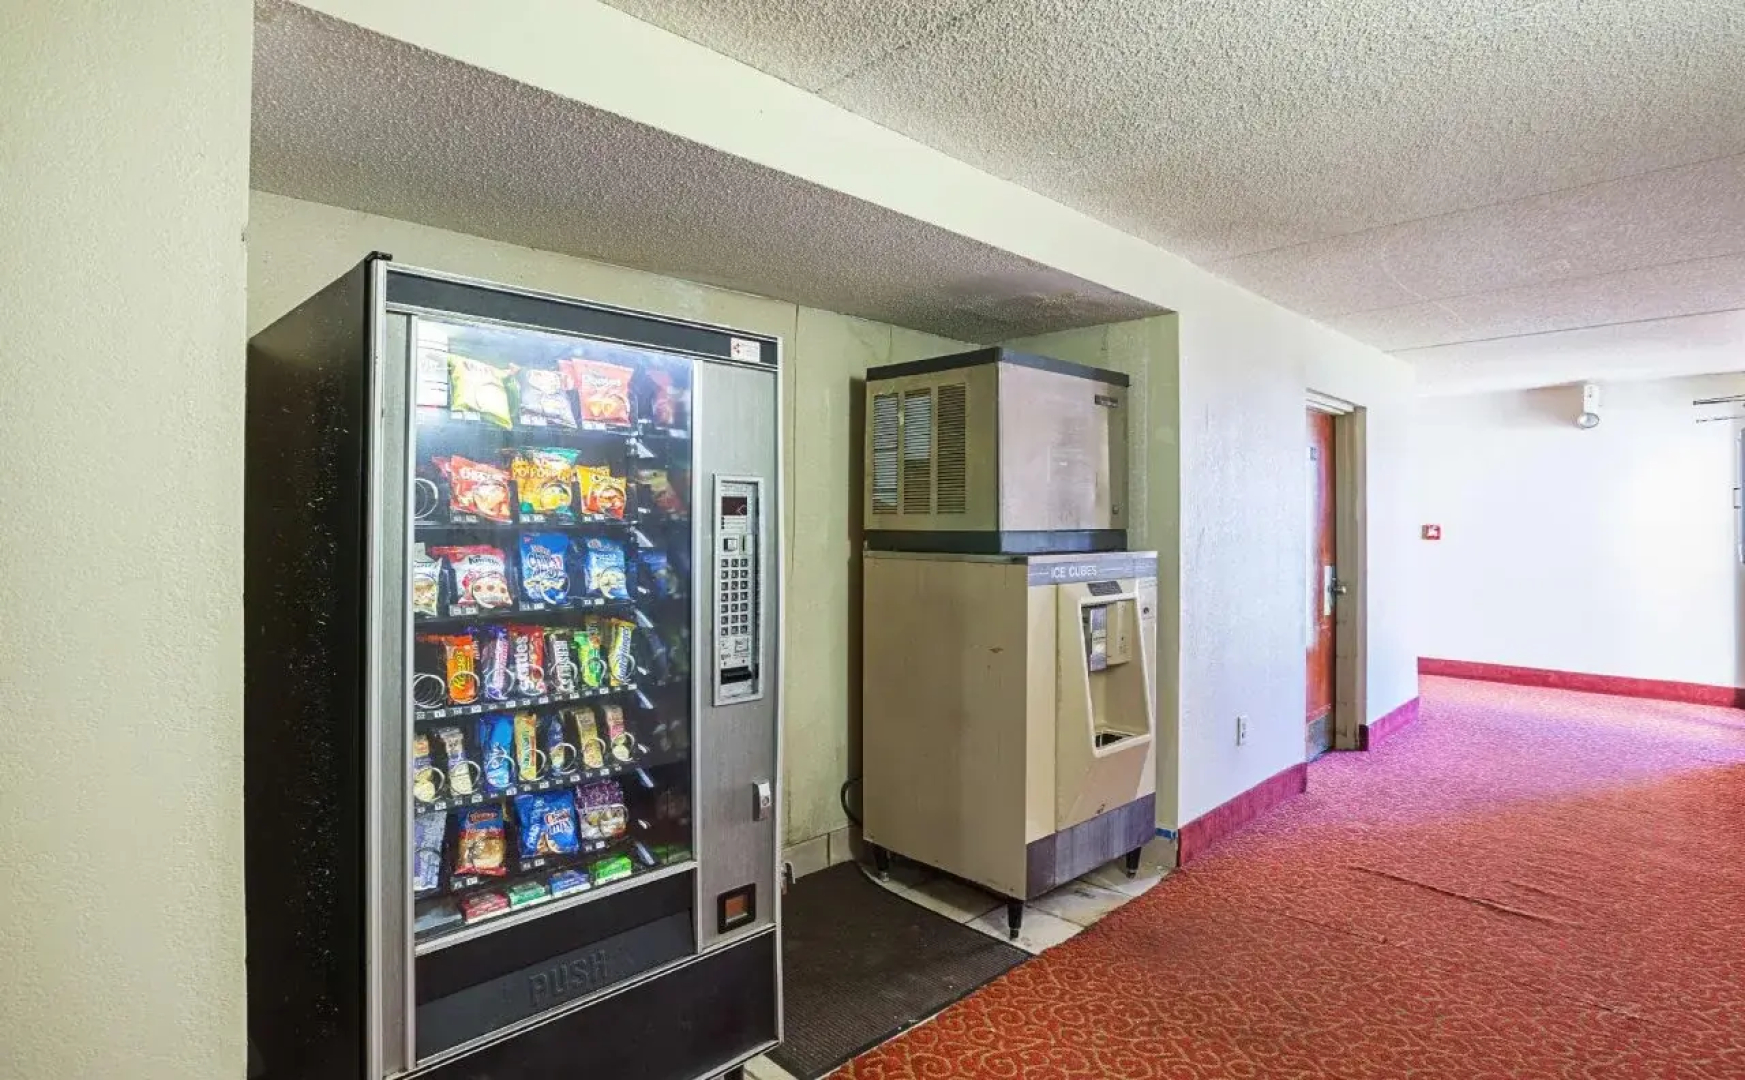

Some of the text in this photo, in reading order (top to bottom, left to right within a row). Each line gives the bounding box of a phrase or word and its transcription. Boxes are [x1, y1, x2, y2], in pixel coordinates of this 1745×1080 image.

[1050, 565, 1097, 579] ICE CUBES
[529, 949, 608, 1007] PUSH
